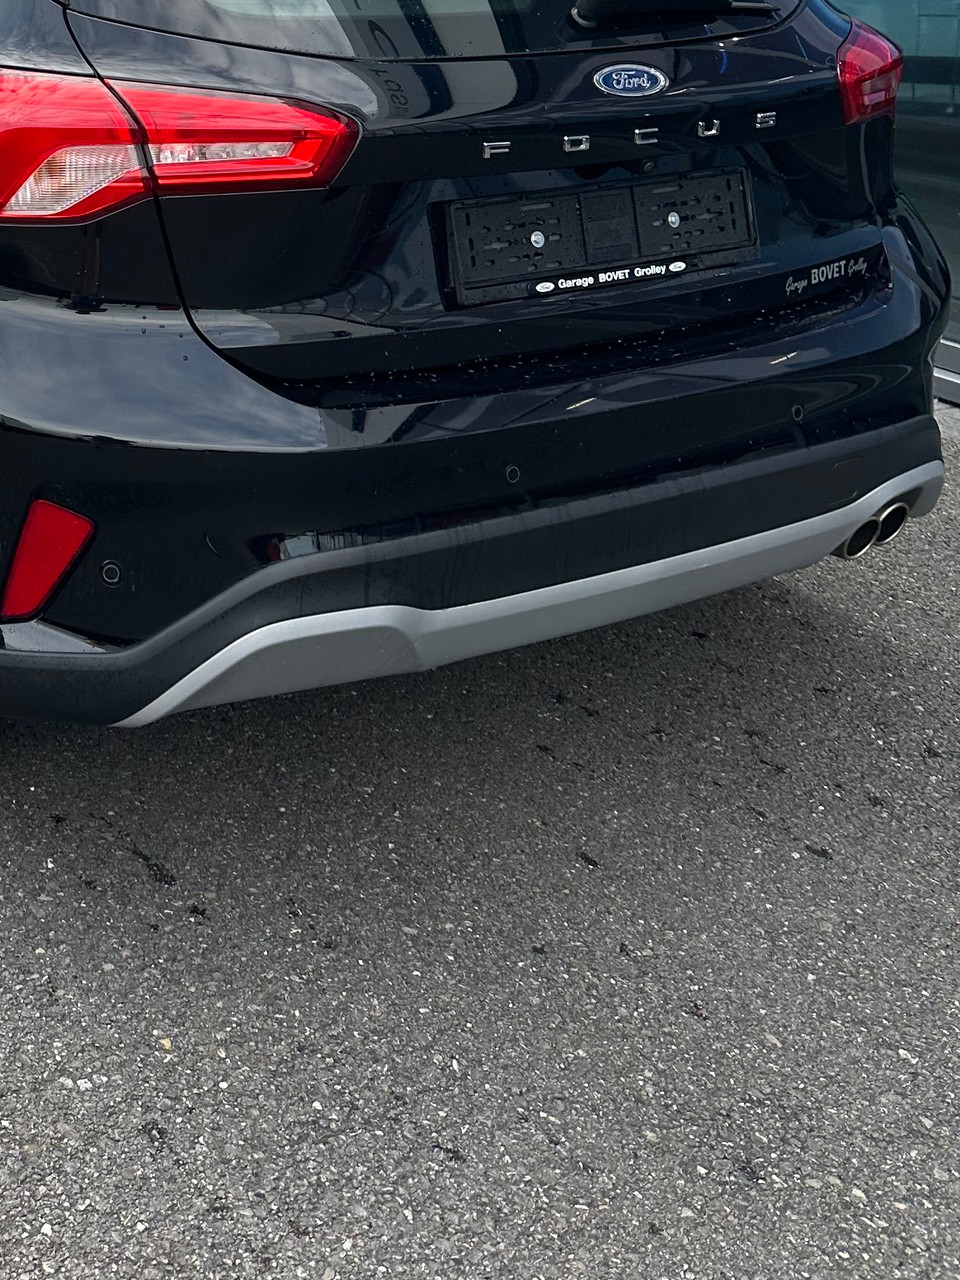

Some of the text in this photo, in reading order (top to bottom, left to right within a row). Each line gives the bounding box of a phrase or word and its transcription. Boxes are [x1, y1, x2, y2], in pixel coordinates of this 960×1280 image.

[612, 70, 651, 89] Ford
[483, 111, 777, 159] FOCUS
[558, 276, 594, 289] Garage
[598, 269, 630, 283] BOVET
[634, 264, 666, 277] Grolley
[811, 260, 846, 285] BOVET
